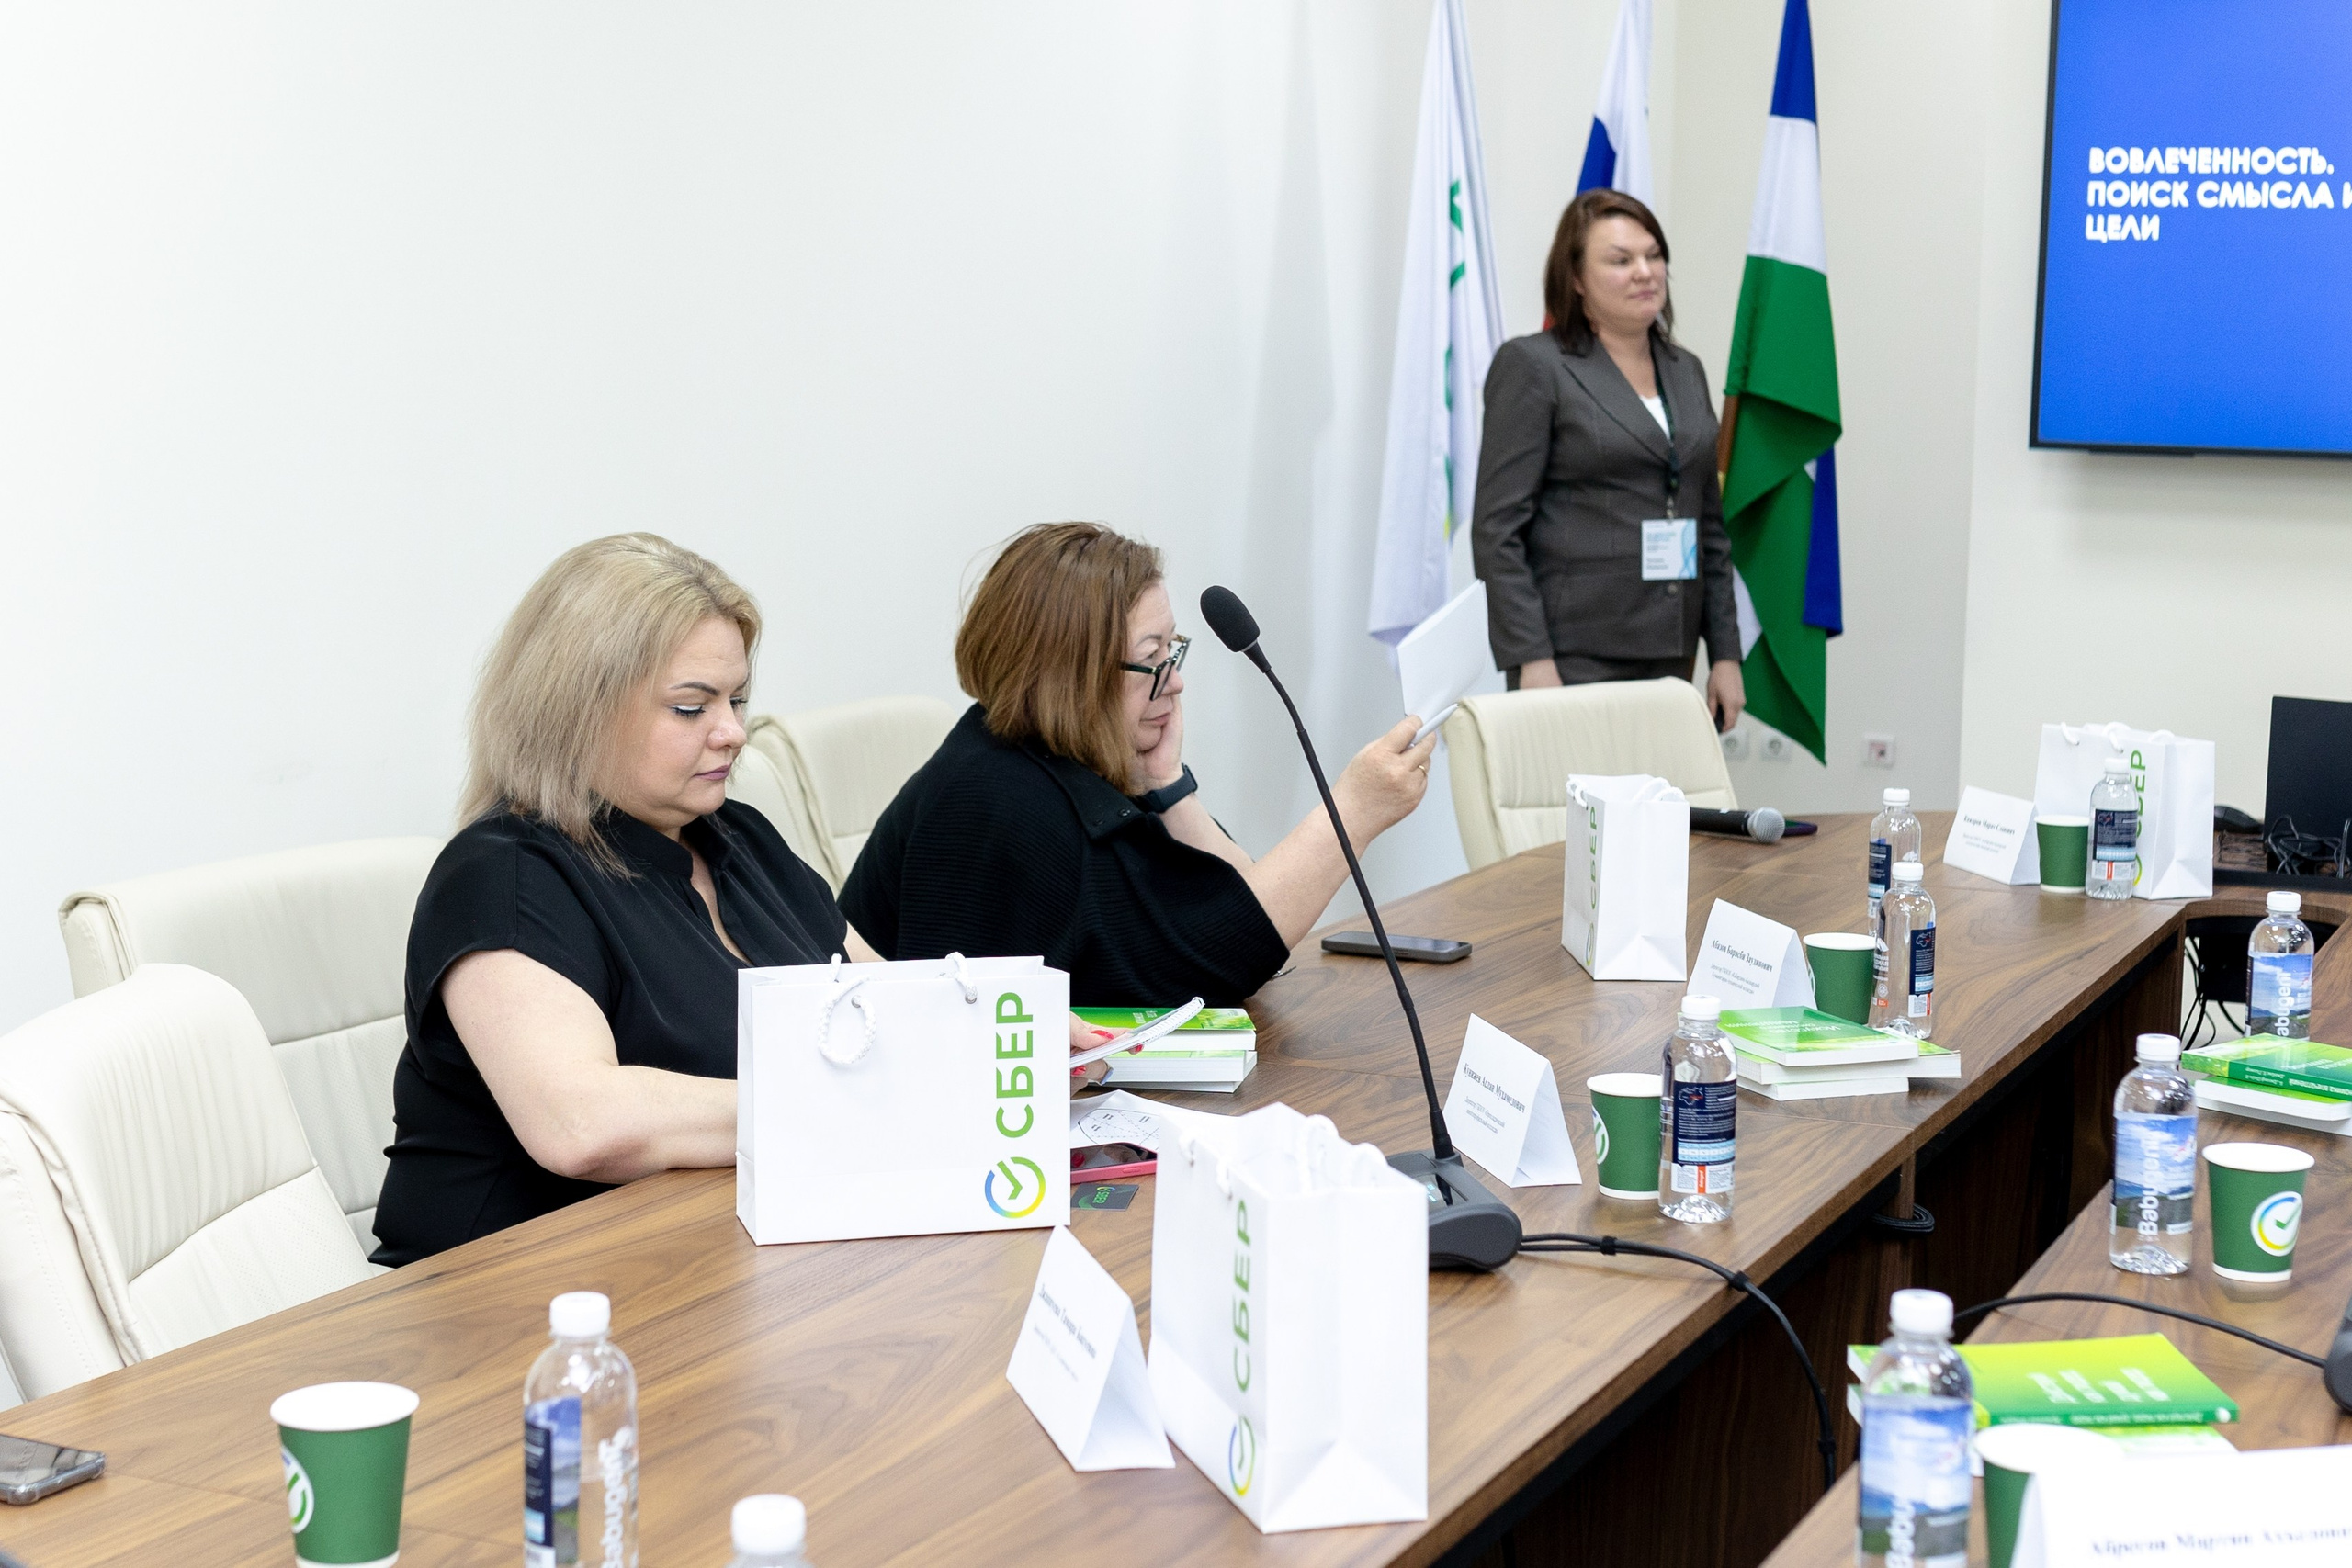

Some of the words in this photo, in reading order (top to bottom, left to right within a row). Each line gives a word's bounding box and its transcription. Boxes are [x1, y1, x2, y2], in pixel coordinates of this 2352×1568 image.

[2089, 146, 2335, 175] ВОВЛЕЧЕННОСТЬ.
[2087, 180, 2189, 208] ПОИСК
[2196, 180, 2335, 209] СМЫСЛА
[2085, 214, 2160, 243] ЦЕЛИ
[1589, 806, 1598, 910] СБЕР
[995, 991, 1035, 1139] СБЕР
[1232, 1198, 1251, 1393] СБЕР
